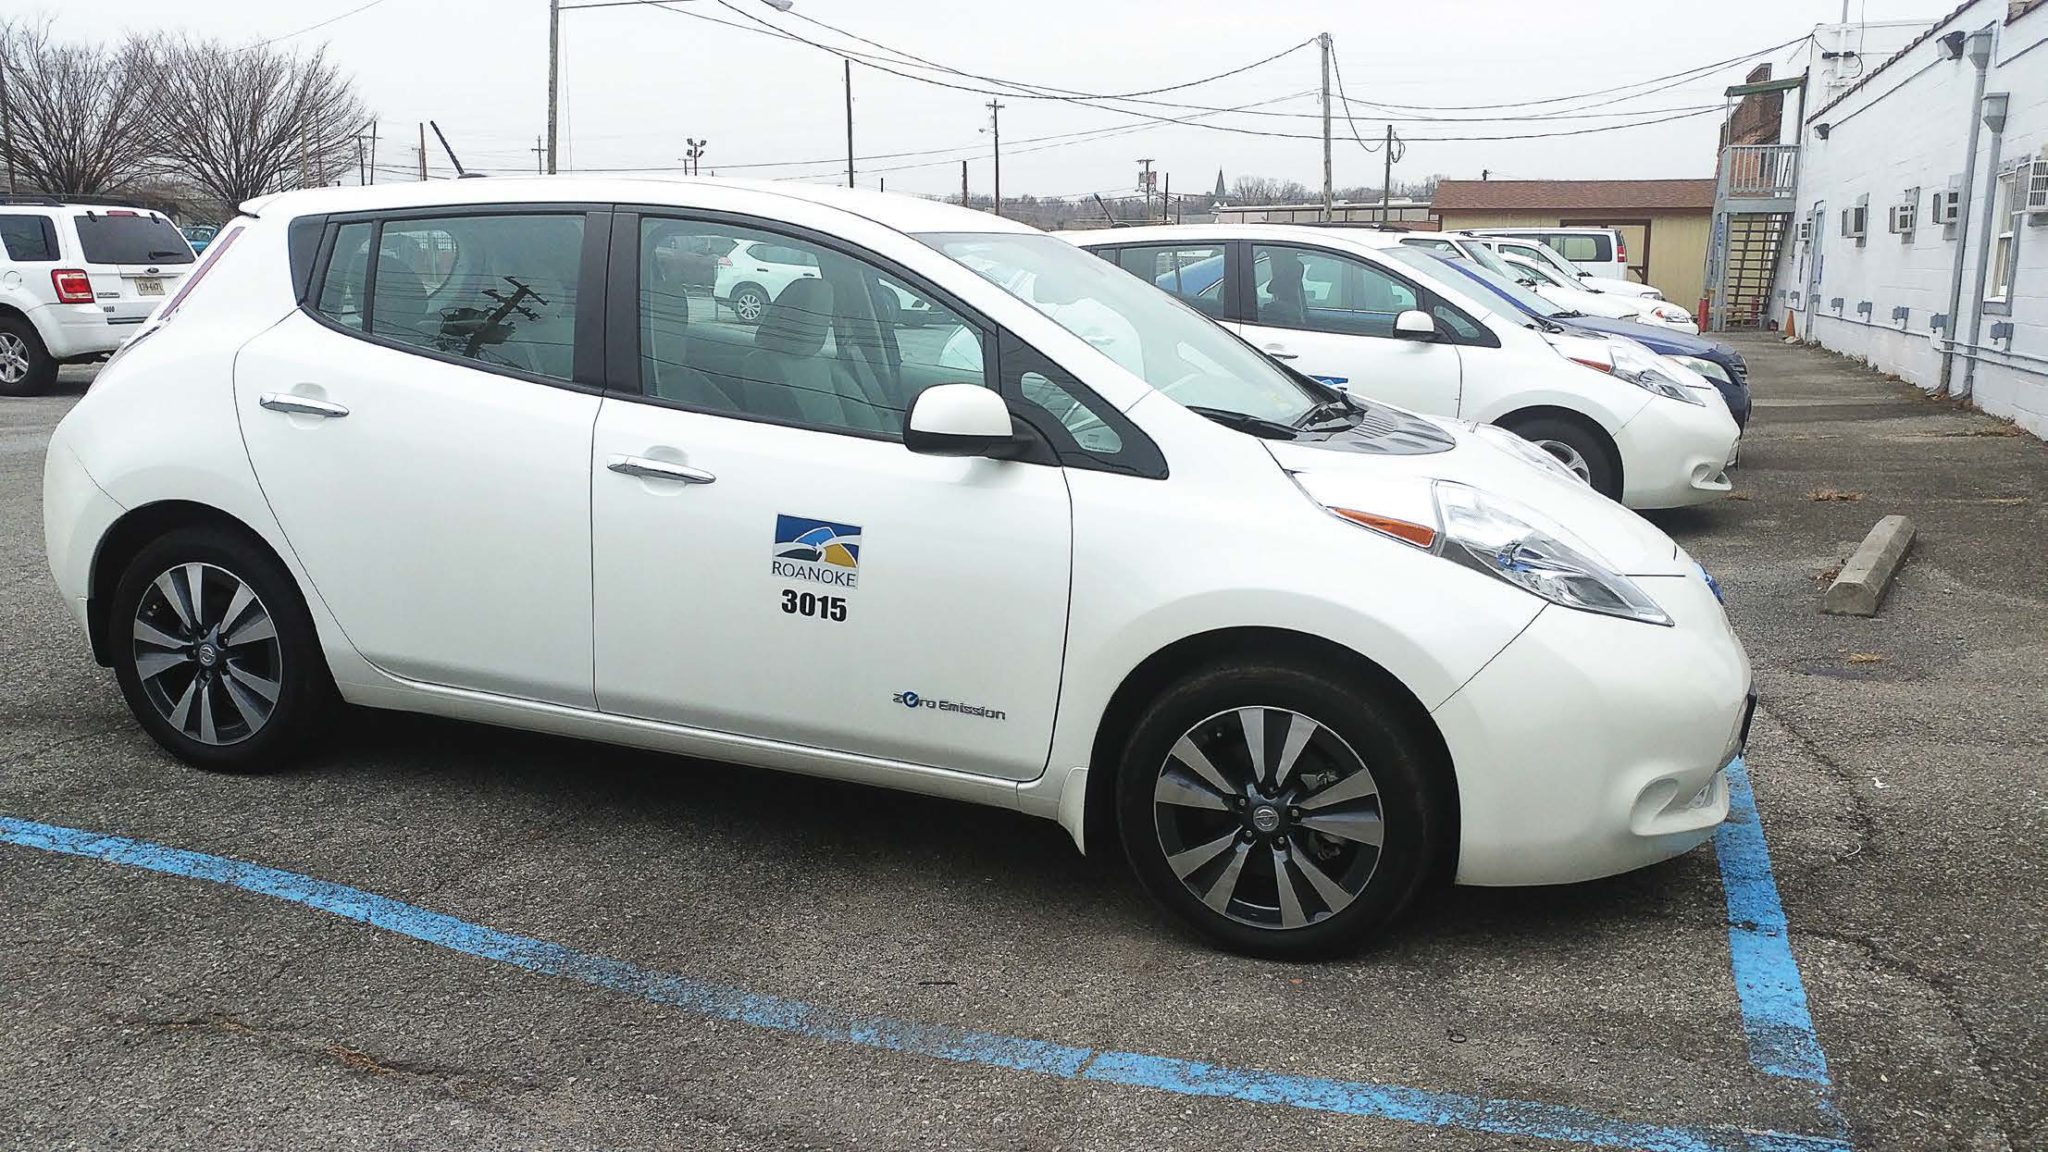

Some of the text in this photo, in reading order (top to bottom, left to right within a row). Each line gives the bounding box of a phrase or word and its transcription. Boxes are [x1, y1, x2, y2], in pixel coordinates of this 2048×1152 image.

[772, 561, 856, 588] ROANOKE
[781, 589, 847, 622] 3015
[938, 700, 1006, 720] Emission
